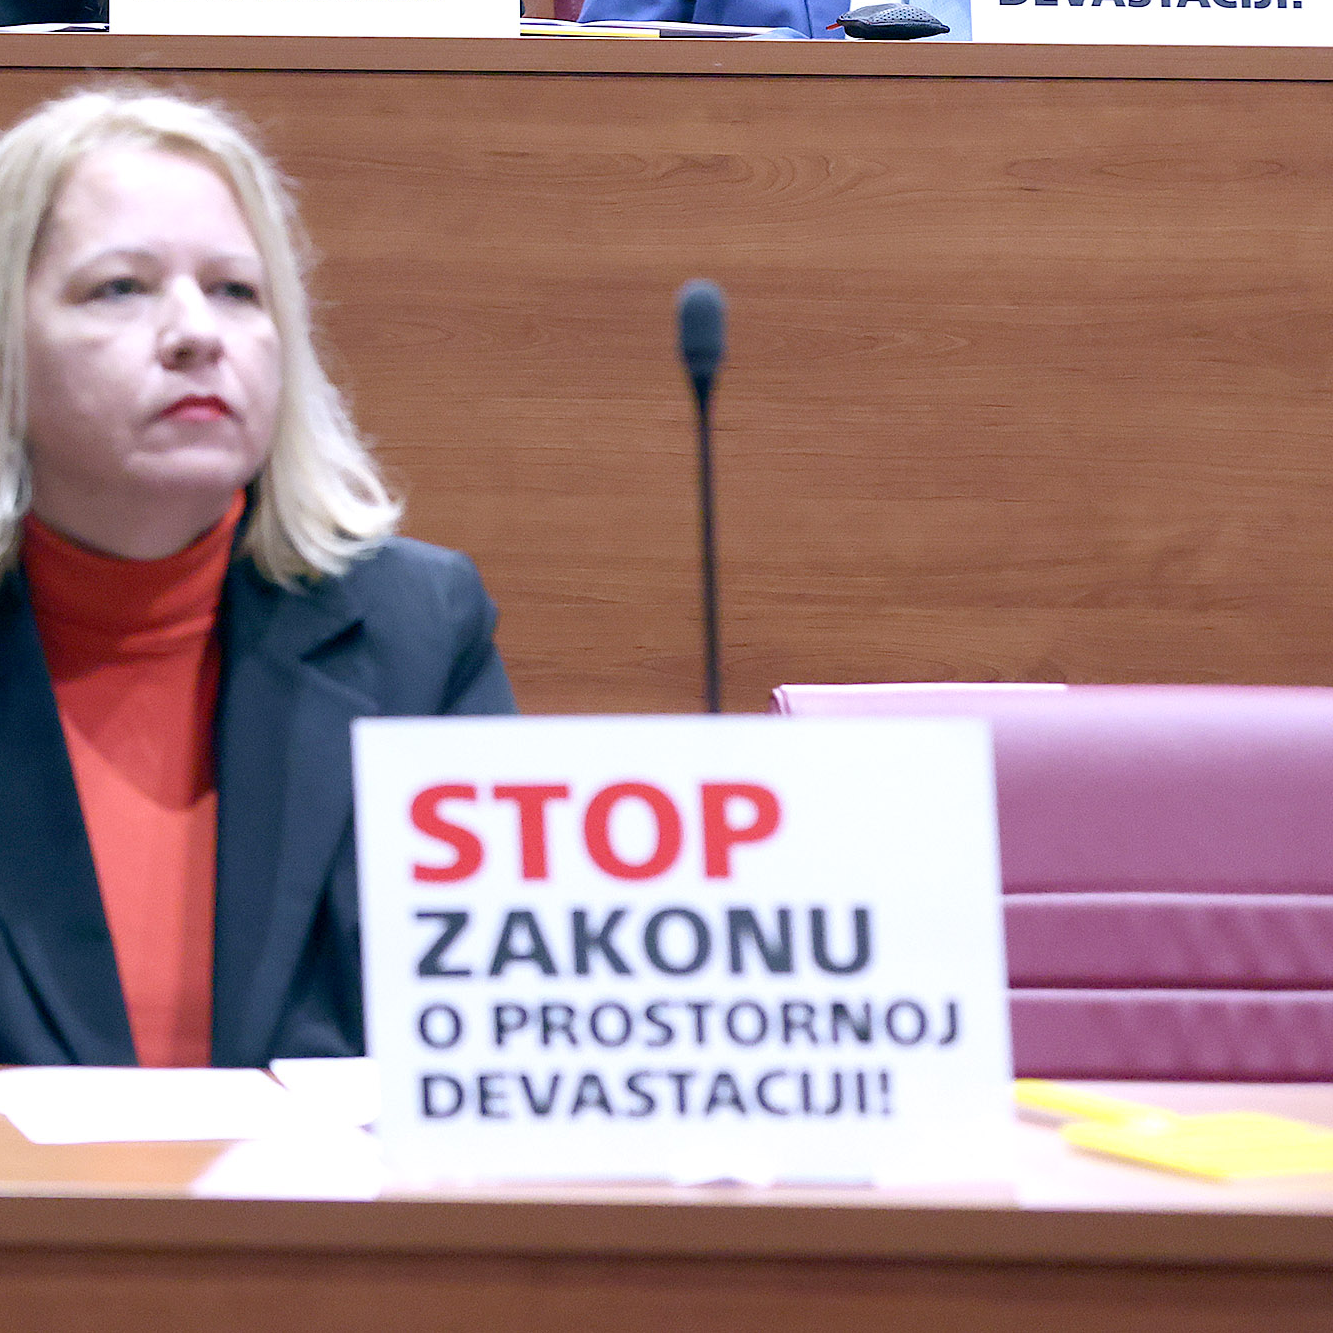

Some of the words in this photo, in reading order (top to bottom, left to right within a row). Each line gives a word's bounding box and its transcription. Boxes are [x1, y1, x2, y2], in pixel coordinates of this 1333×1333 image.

[410, 781, 781, 884] STOP
[415, 907, 871, 978] ZAKONU
[418, 1002, 463, 1049] O
[493, 1001, 959, 1047] PROSTORNOJ
[421, 1071, 890, 1118] DEVASTACIJI!
